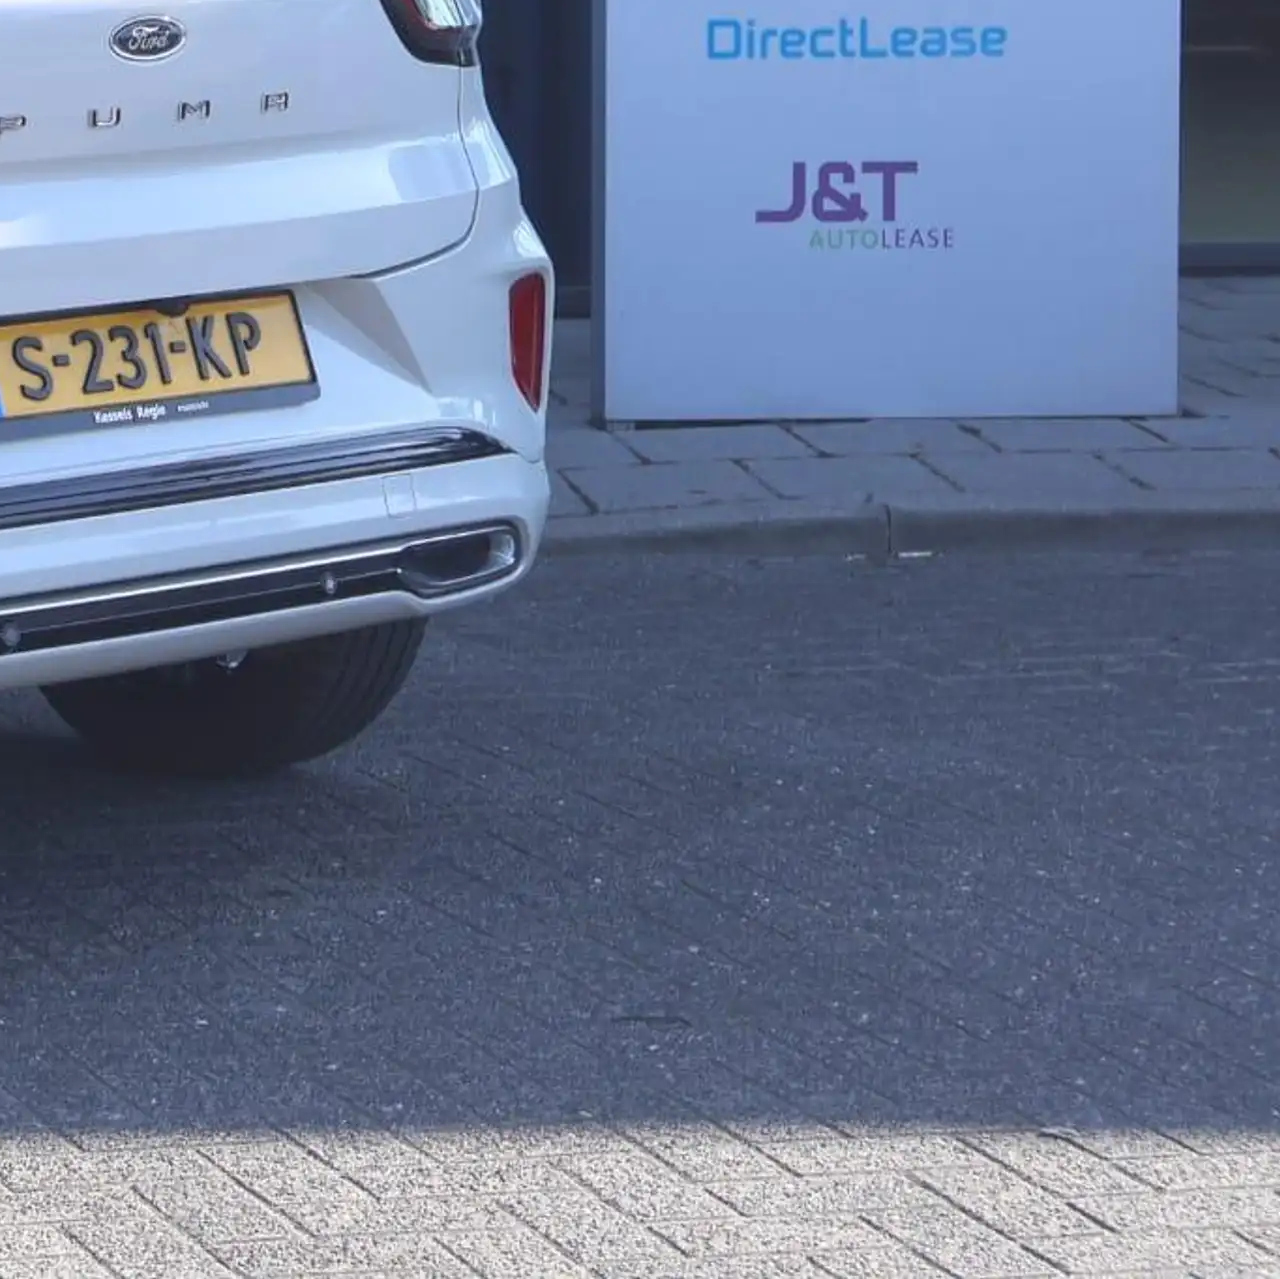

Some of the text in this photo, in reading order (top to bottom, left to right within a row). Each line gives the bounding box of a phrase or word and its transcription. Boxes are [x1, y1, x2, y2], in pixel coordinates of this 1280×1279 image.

[707, 17, 1007, 60] DirectLease
[755, 160, 919, 223] J&T
[809, 227, 955, 250] AUTOLEASE
[12, 311, 262, 401] S-231-KP
